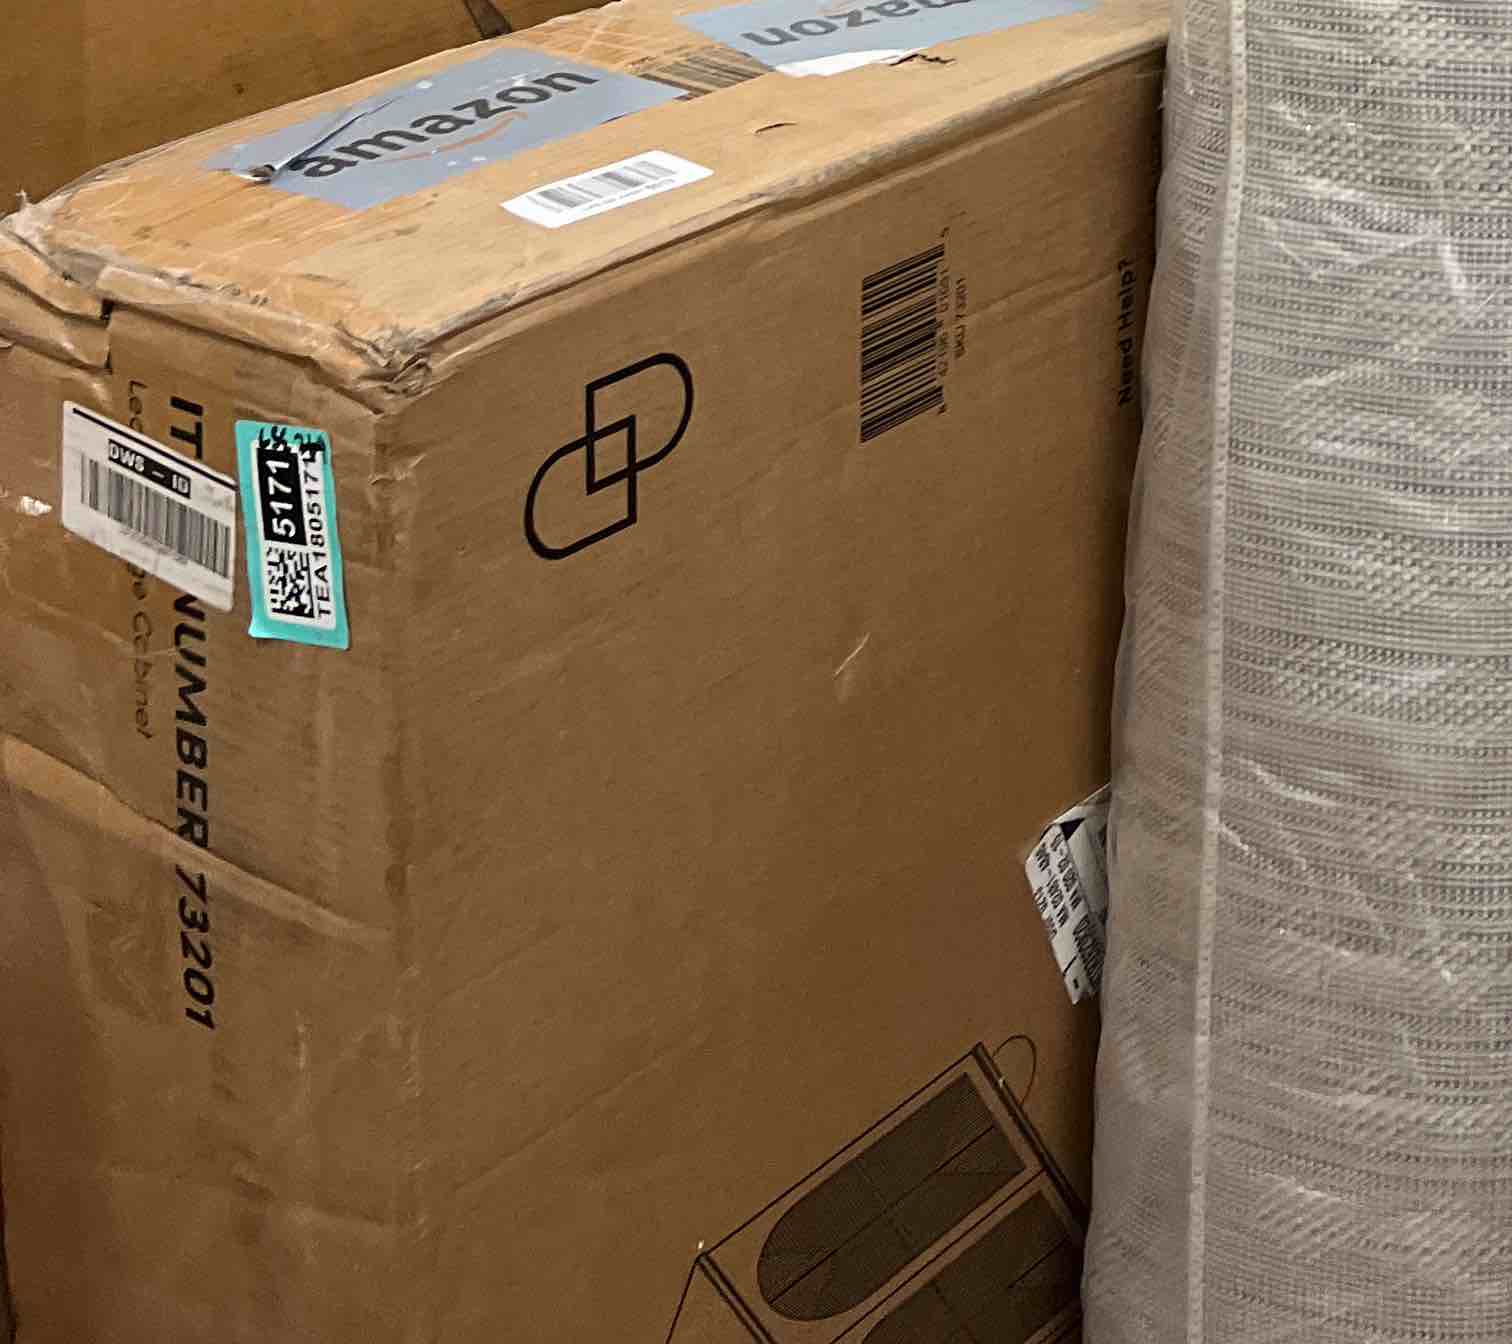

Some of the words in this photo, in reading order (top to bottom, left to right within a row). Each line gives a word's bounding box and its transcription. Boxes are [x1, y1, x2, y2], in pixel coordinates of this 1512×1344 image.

[287, 70, 601, 179] amazon
[1116, 256, 1137, 332] Help?
[1117, 336, 1134, 407] Need
[169, 395, 204, 460] IT
[264, 458, 297, 539] 5171
[175, 863, 217, 1031] 73201
